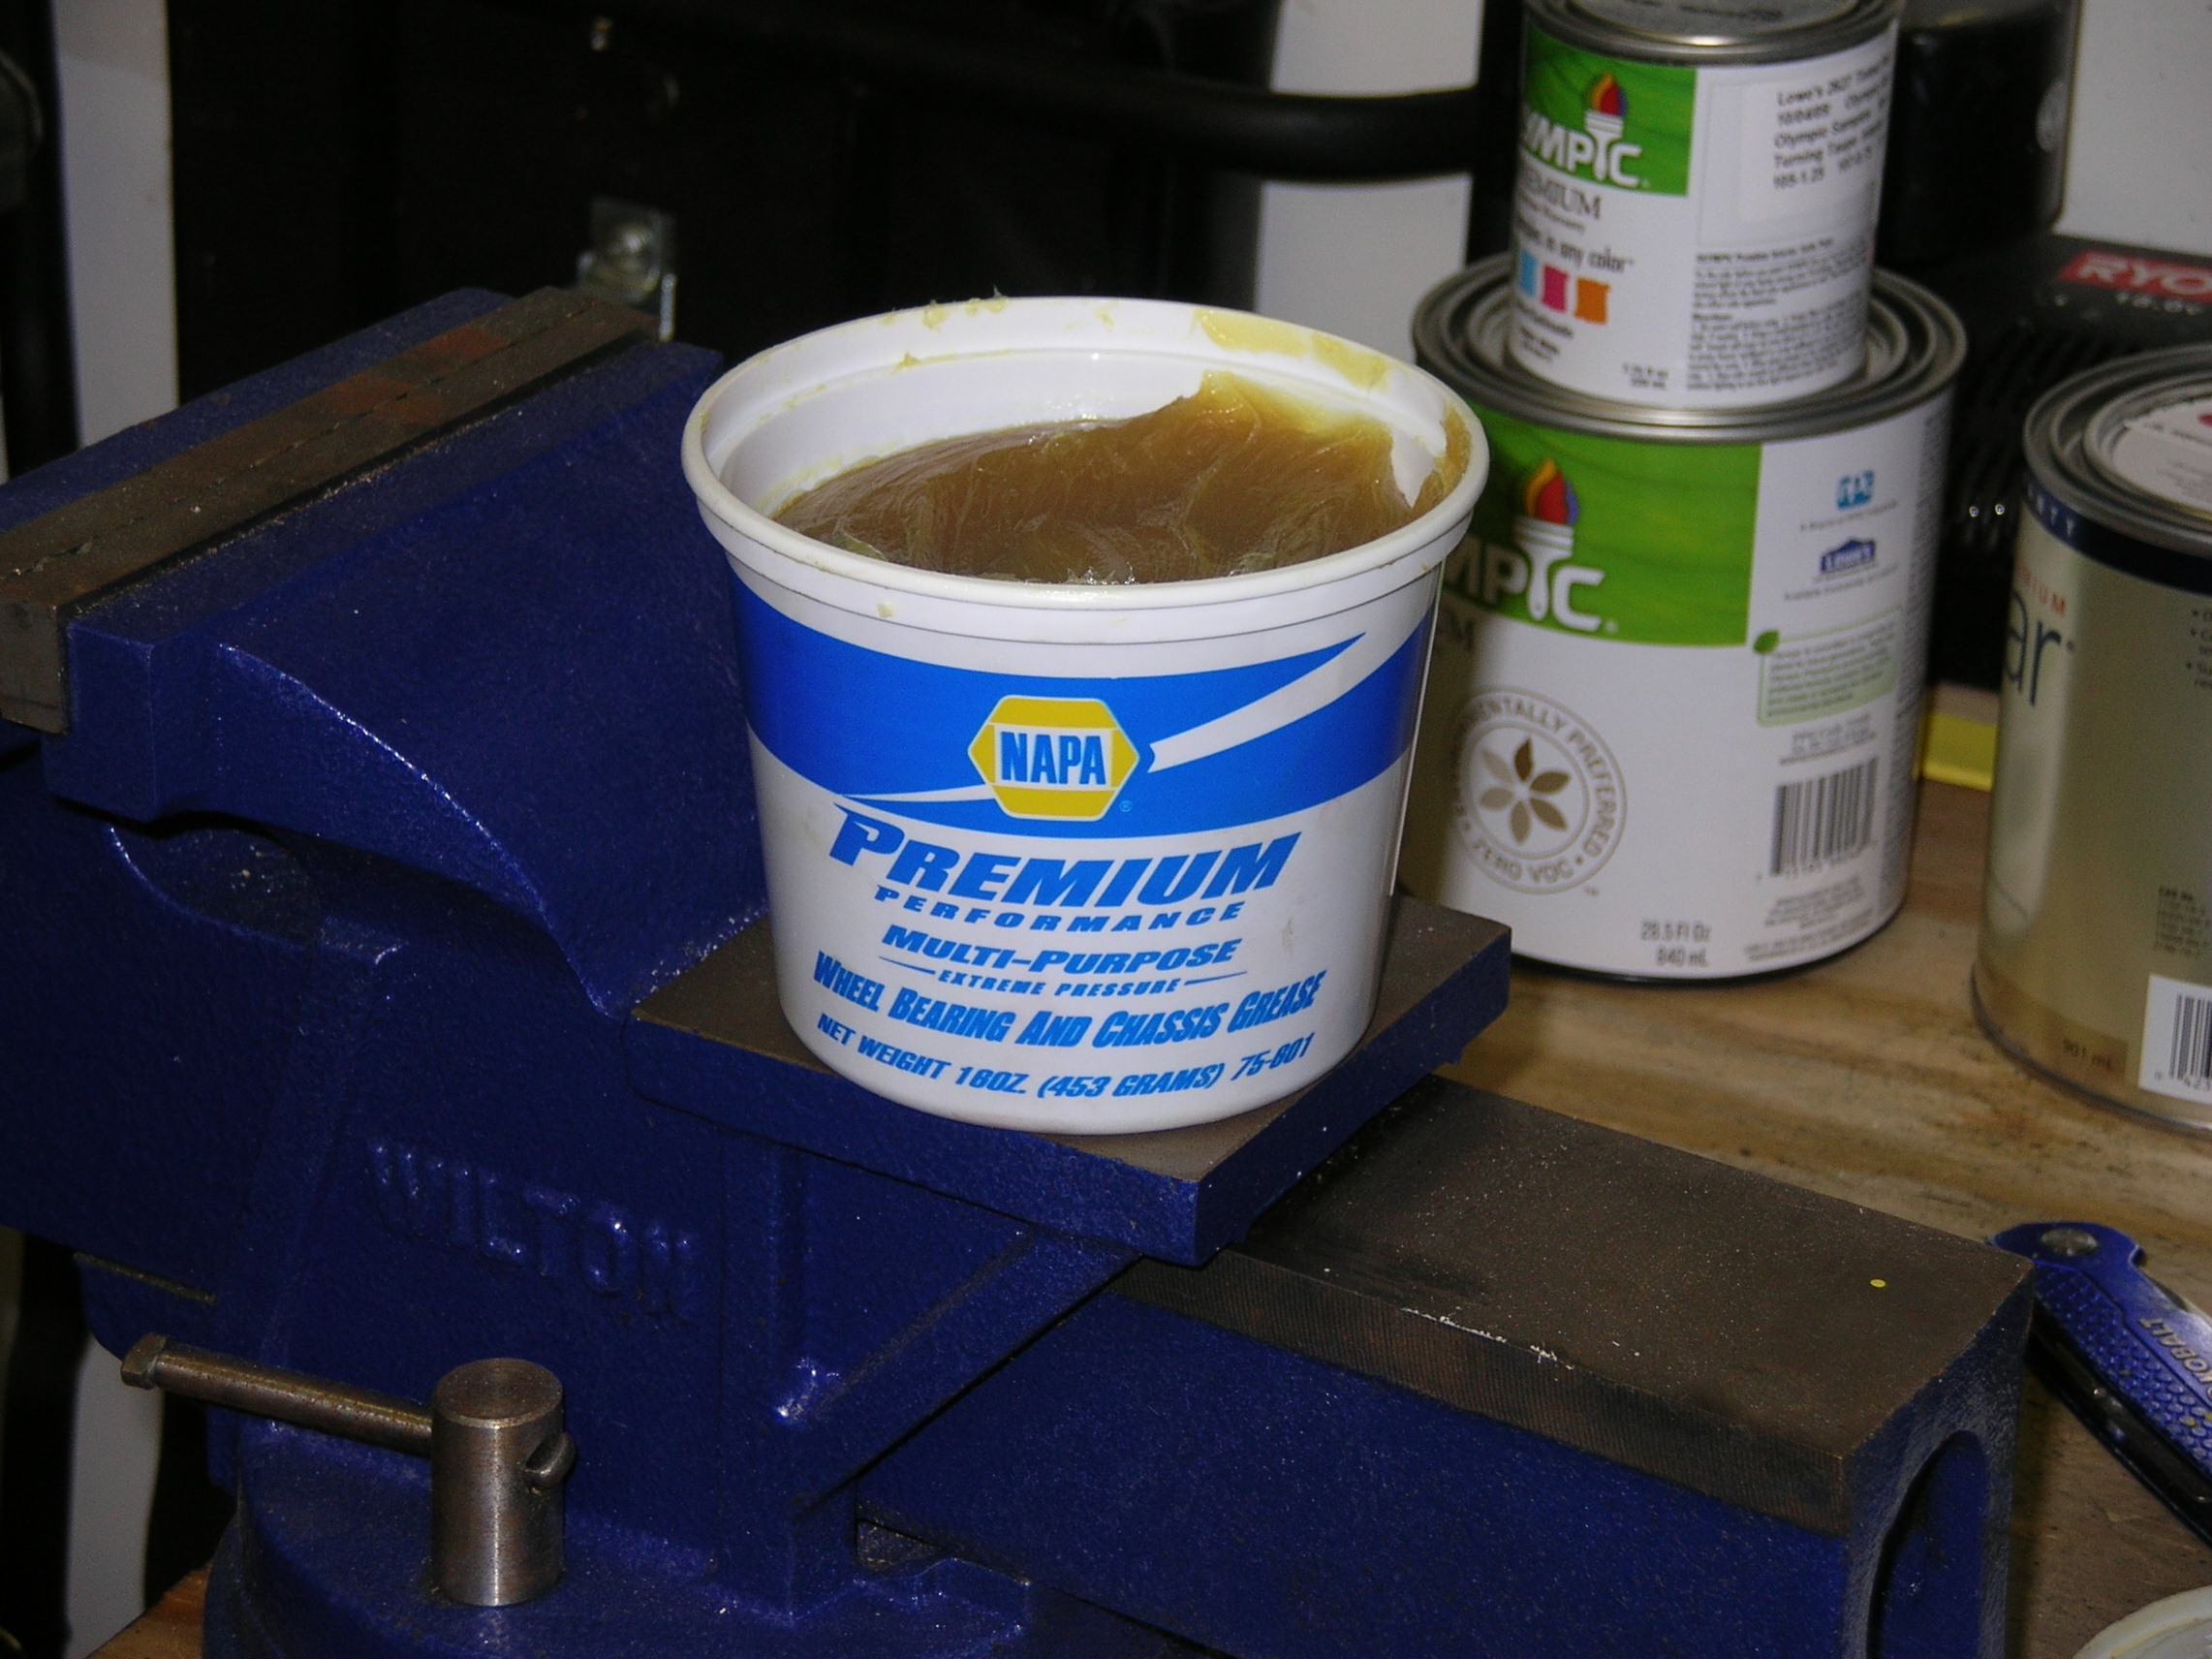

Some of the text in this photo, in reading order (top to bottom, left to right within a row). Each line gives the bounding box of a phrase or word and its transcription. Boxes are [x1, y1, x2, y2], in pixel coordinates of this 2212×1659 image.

[1001, 731, 1106, 786] NAPA
[828, 803, 1302, 908] PREMIUM
[874, 885, 1246, 932] PERFORMANCE
[882, 923, 1242, 976] MULTI-PURPOSE
[937, 969, 1182, 997] EXTREME PRESSURE
[813, 950, 1327, 1049] WHEEL BEARING AND CHASSIS GREASE
[816, 1013, 857, 1047] NET
[857, 1035, 952, 1080] WEIGHT
[1037, 1075, 1112, 1098] (453
[1111, 1062, 1226, 1097] GRAMS)
[368, 1136, 700, 1324] WILTON
